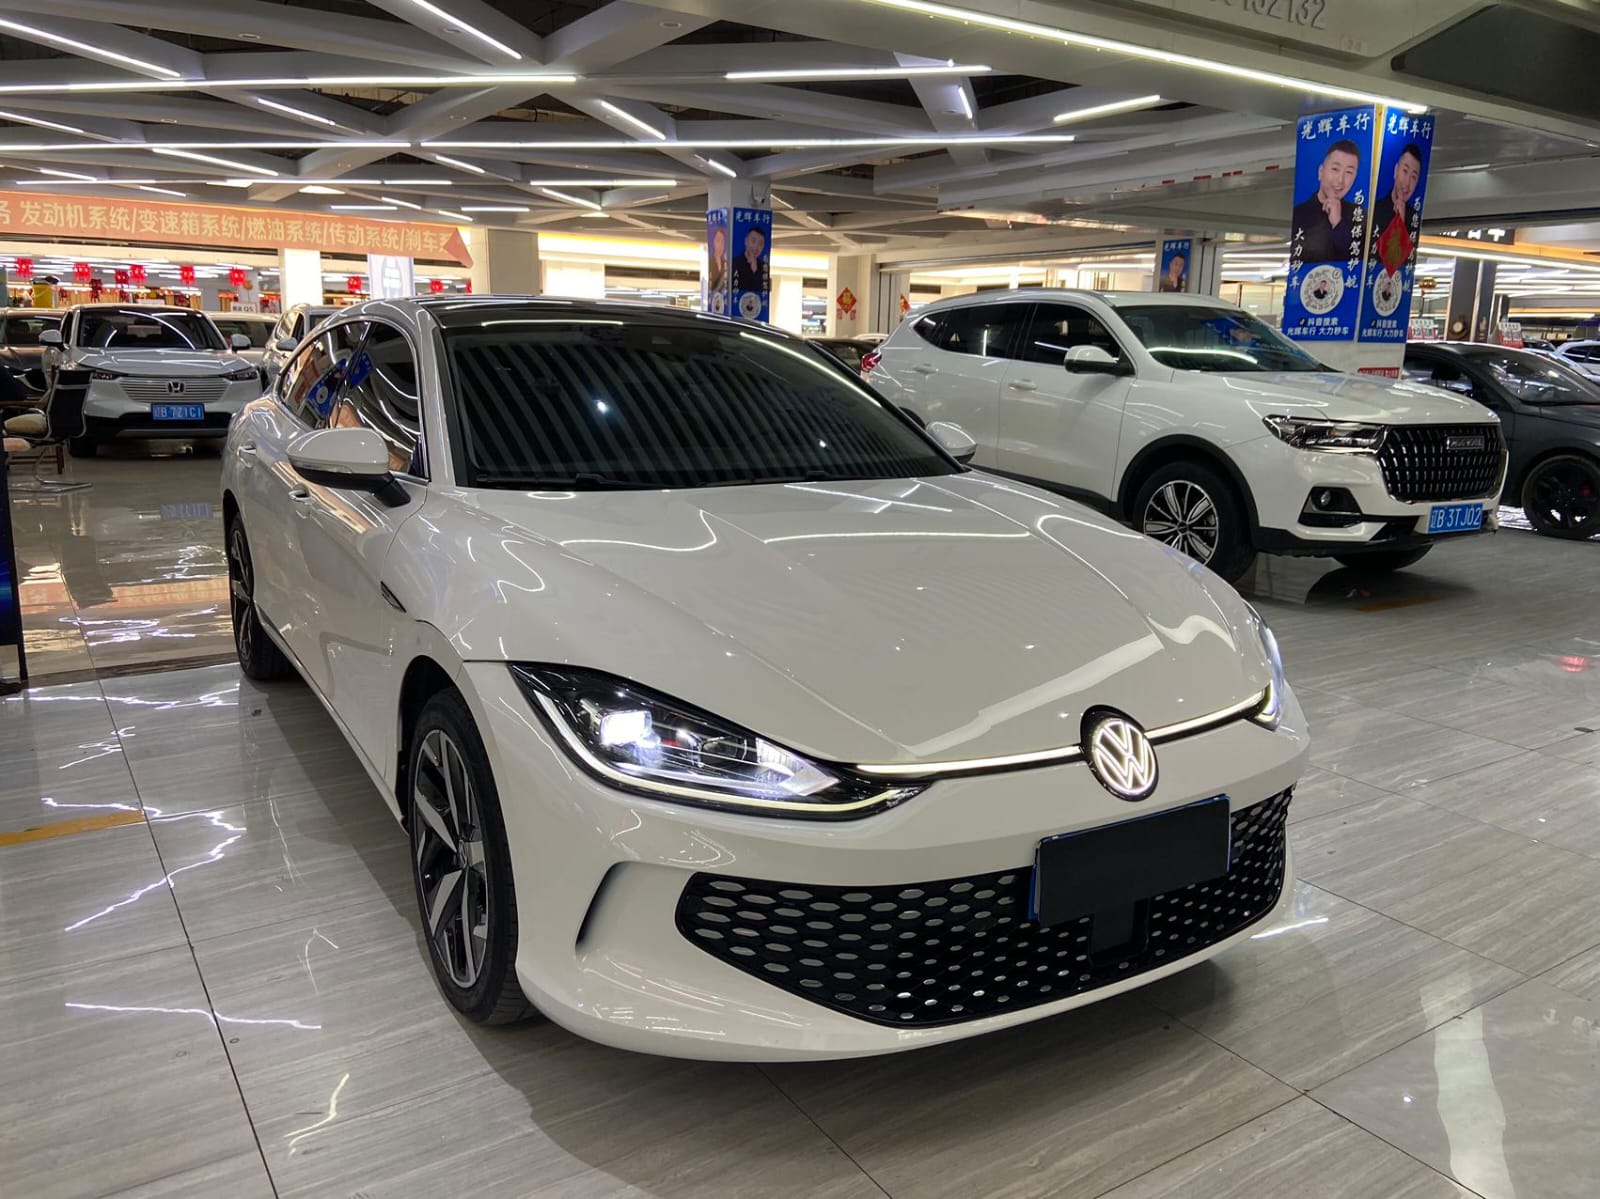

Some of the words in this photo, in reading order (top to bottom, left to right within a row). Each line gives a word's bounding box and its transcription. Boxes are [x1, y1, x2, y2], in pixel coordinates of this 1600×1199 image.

[1208, 0, 1326, 30] 2132
[1301, 112, 1371, 140] 光辉车行
[1387, 113, 1432, 139] 光辉车行
